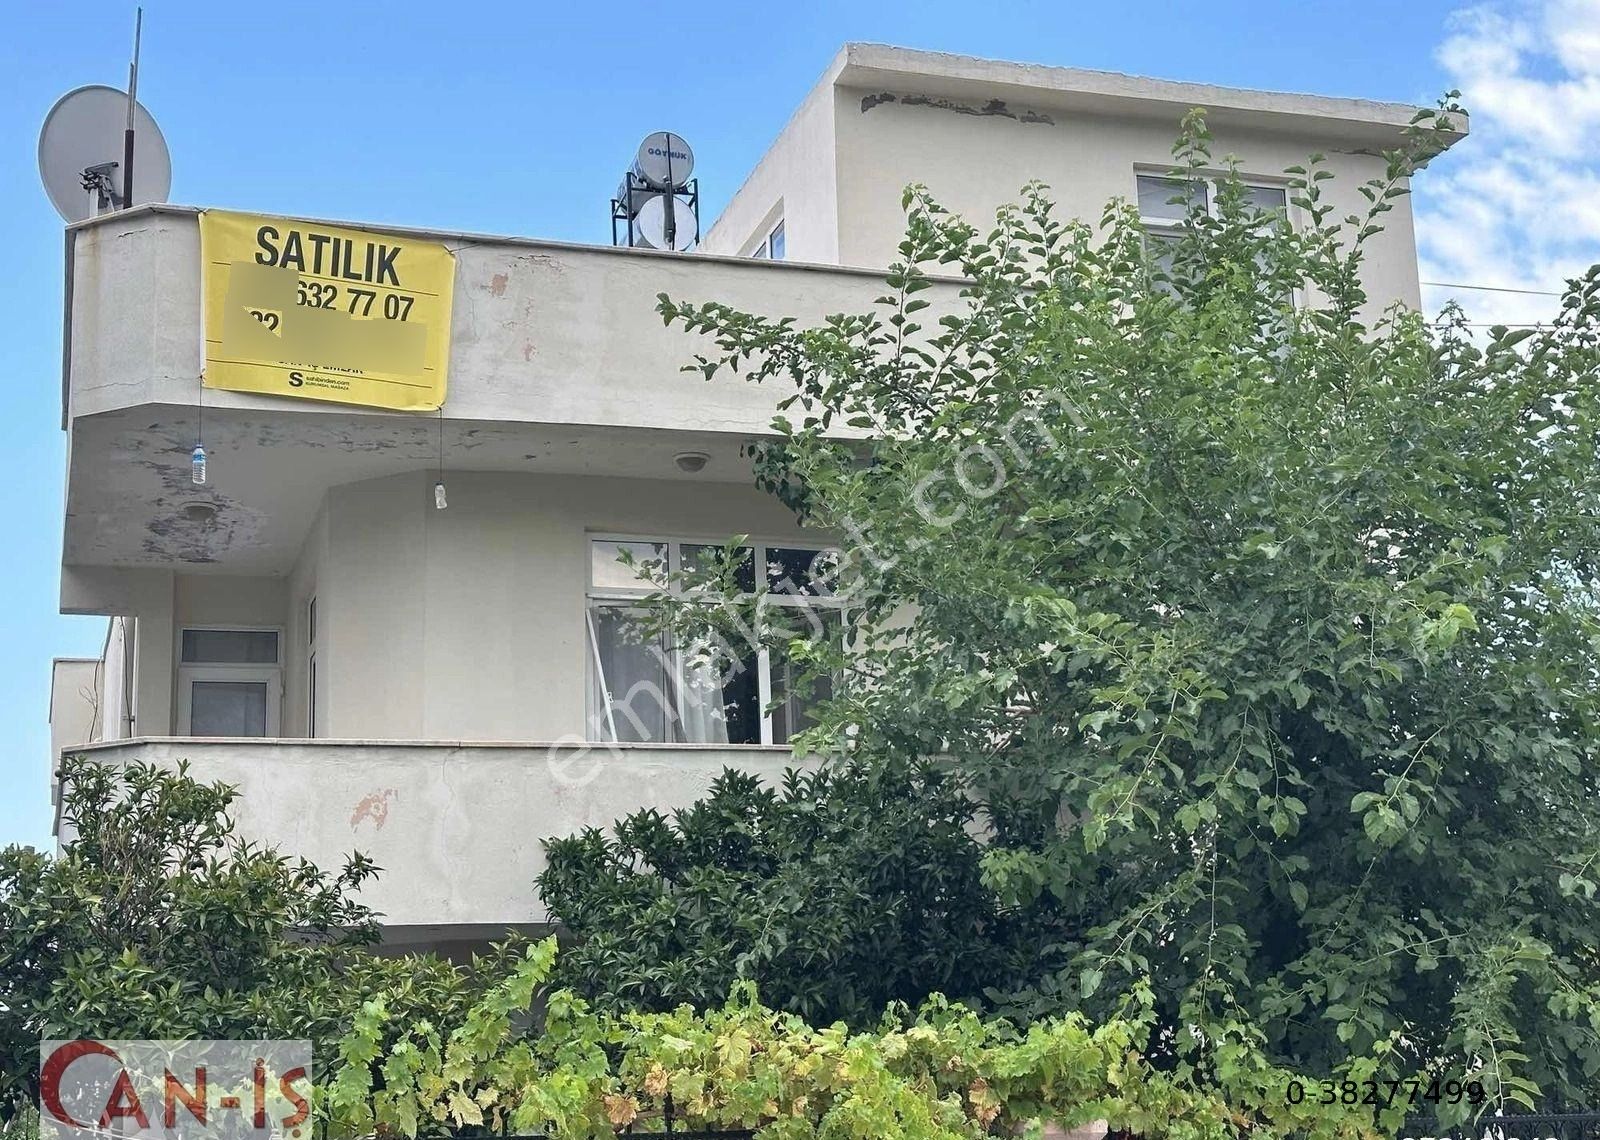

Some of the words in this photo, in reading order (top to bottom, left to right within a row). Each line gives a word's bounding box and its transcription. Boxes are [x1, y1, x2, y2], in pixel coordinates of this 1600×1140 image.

[255, 226, 402, 286] SATILIK
[347, 287, 377, 317] 77
[384, 294, 415, 322] 07
